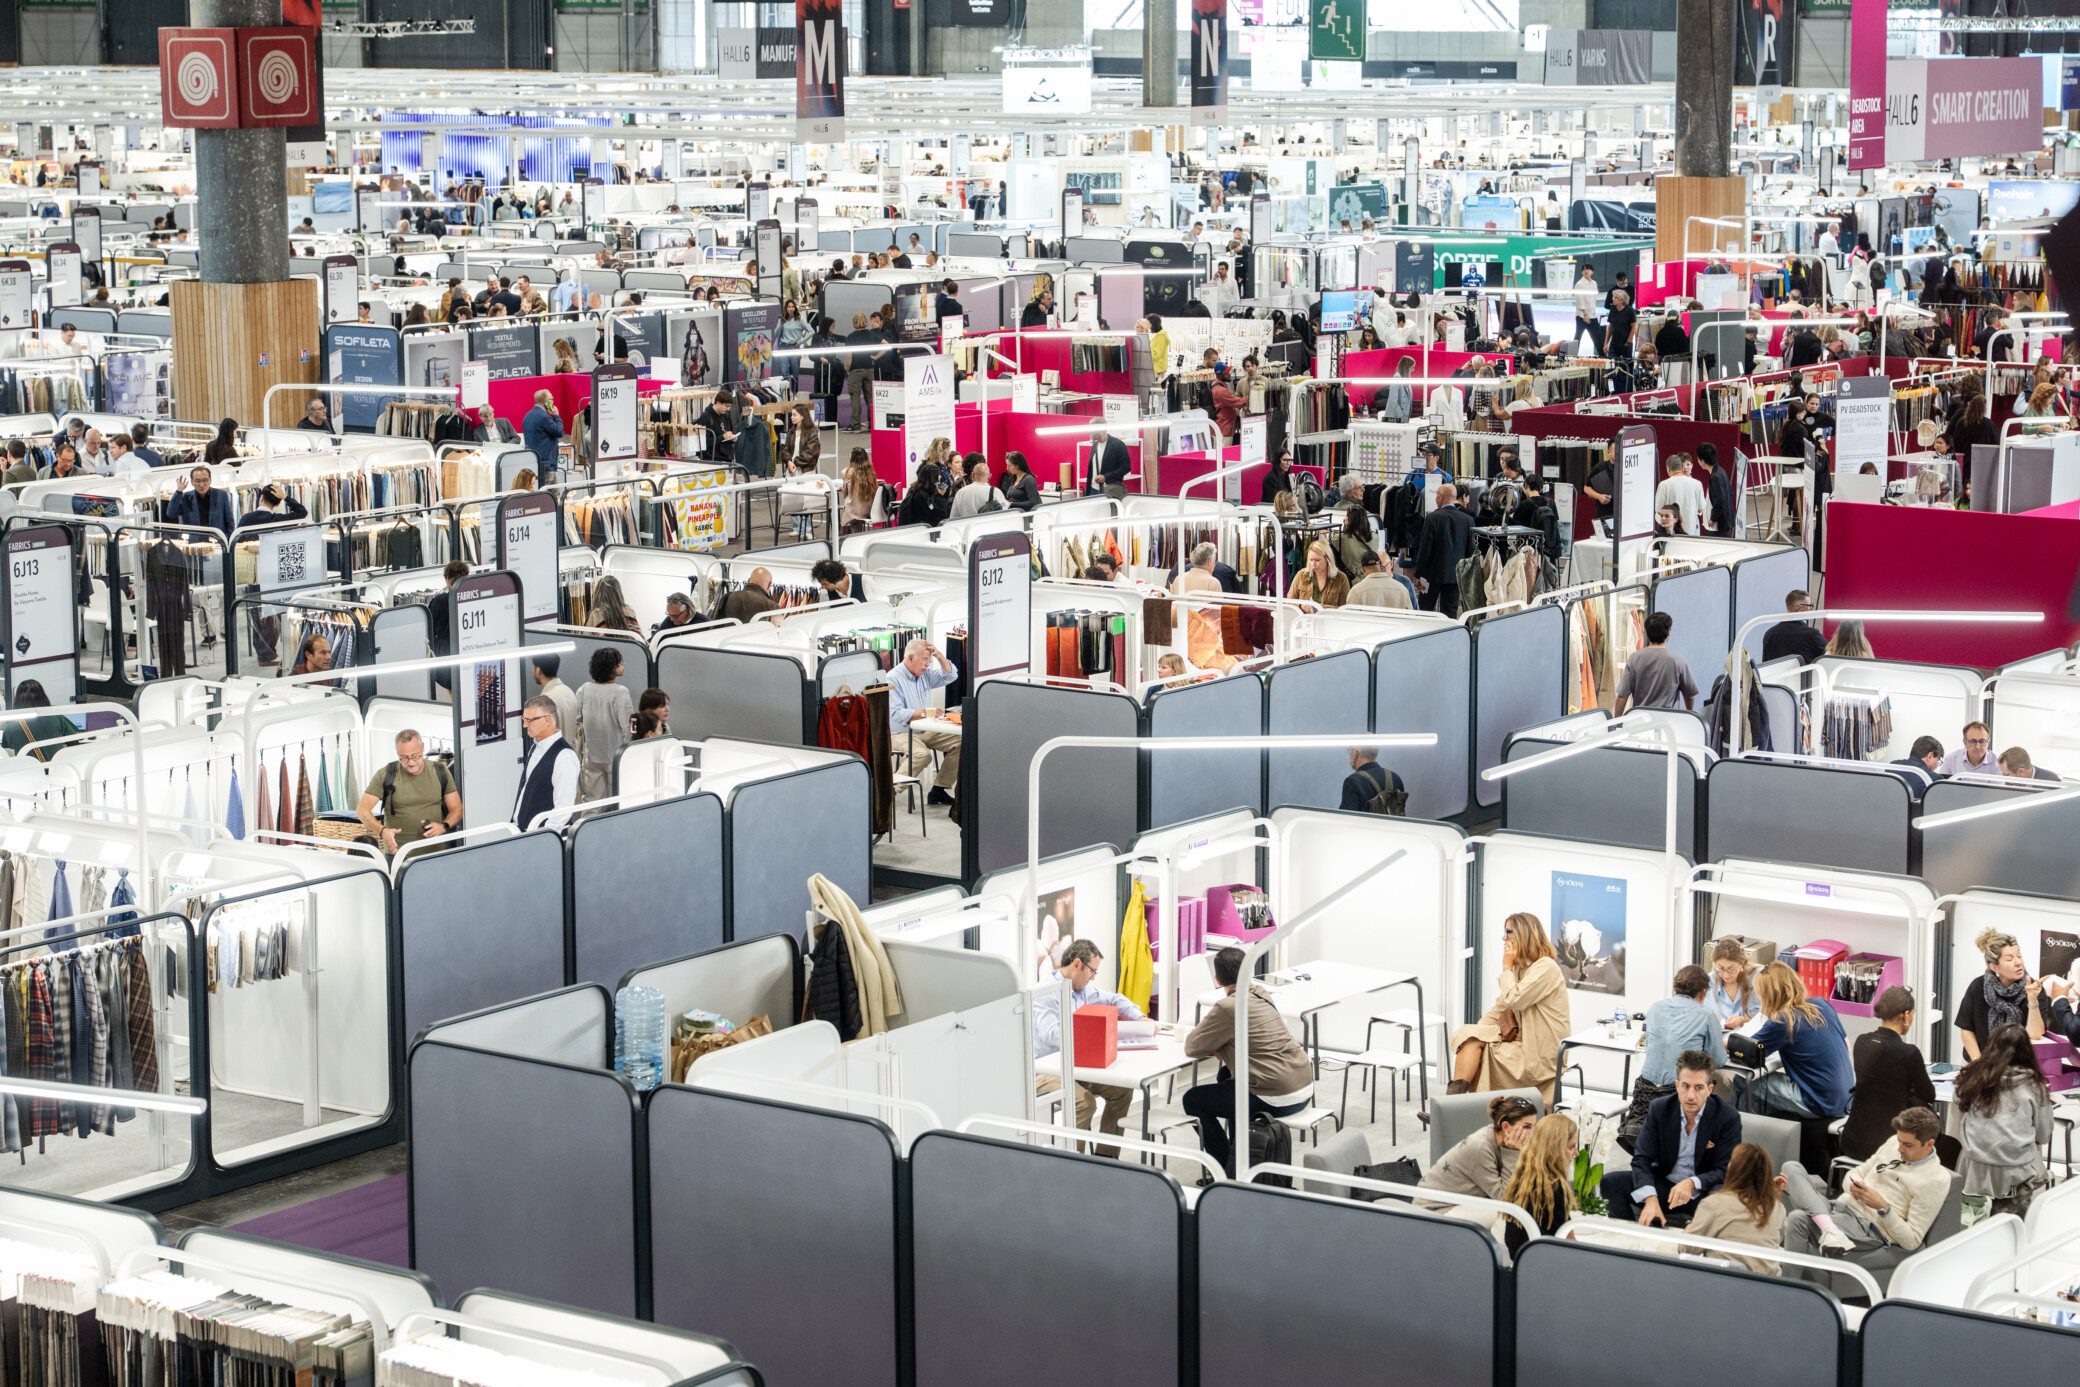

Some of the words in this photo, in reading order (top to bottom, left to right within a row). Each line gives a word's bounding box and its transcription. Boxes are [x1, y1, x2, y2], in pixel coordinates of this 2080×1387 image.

[1763, 14, 1776, 62] R
[804, 19, 836, 85] M
[1200, 19, 1219, 77] N
[1581, 50, 1607, 67] YARNS
[1852, 98, 1881, 114] DEADSTOCK
[1931, 92, 1972, 125] SMART
[1974, 89, 2029, 121] CREATION
[1852, 119, 1864, 134] AREA
[2, 277, 16, 286] 6K38
[329, 272, 342, 280] 6L30
[742, 310, 767, 318] EXCELLENCE
[334, 336, 390, 348] SOFILETA
[488, 366, 532, 380] OFILETA
[600, 388, 618, 400] 6K19
[1106, 403, 1120, 411] 6K20
[1840, 405, 1848, 414] PV
[1849, 404, 1882, 414] DEADSTOCK
[1625, 454, 1639, 468] 6K11
[505, 508, 524, 518] FABRICS
[690, 502, 718, 512] BANANA
[688, 512, 720, 523] PINEAPPLE
[695, 523, 713, 532] FABRIC
[509, 526, 530, 542] 6J14
[8, 540, 31, 550] FABRICS
[979, 548, 997, 559] FABRICS
[14, 560, 39, 578] 6J13
[982, 568, 1003, 586] 6J12
[457, 590, 479, 600] FABRICS
[462, 610, 486, 630] 6J11
